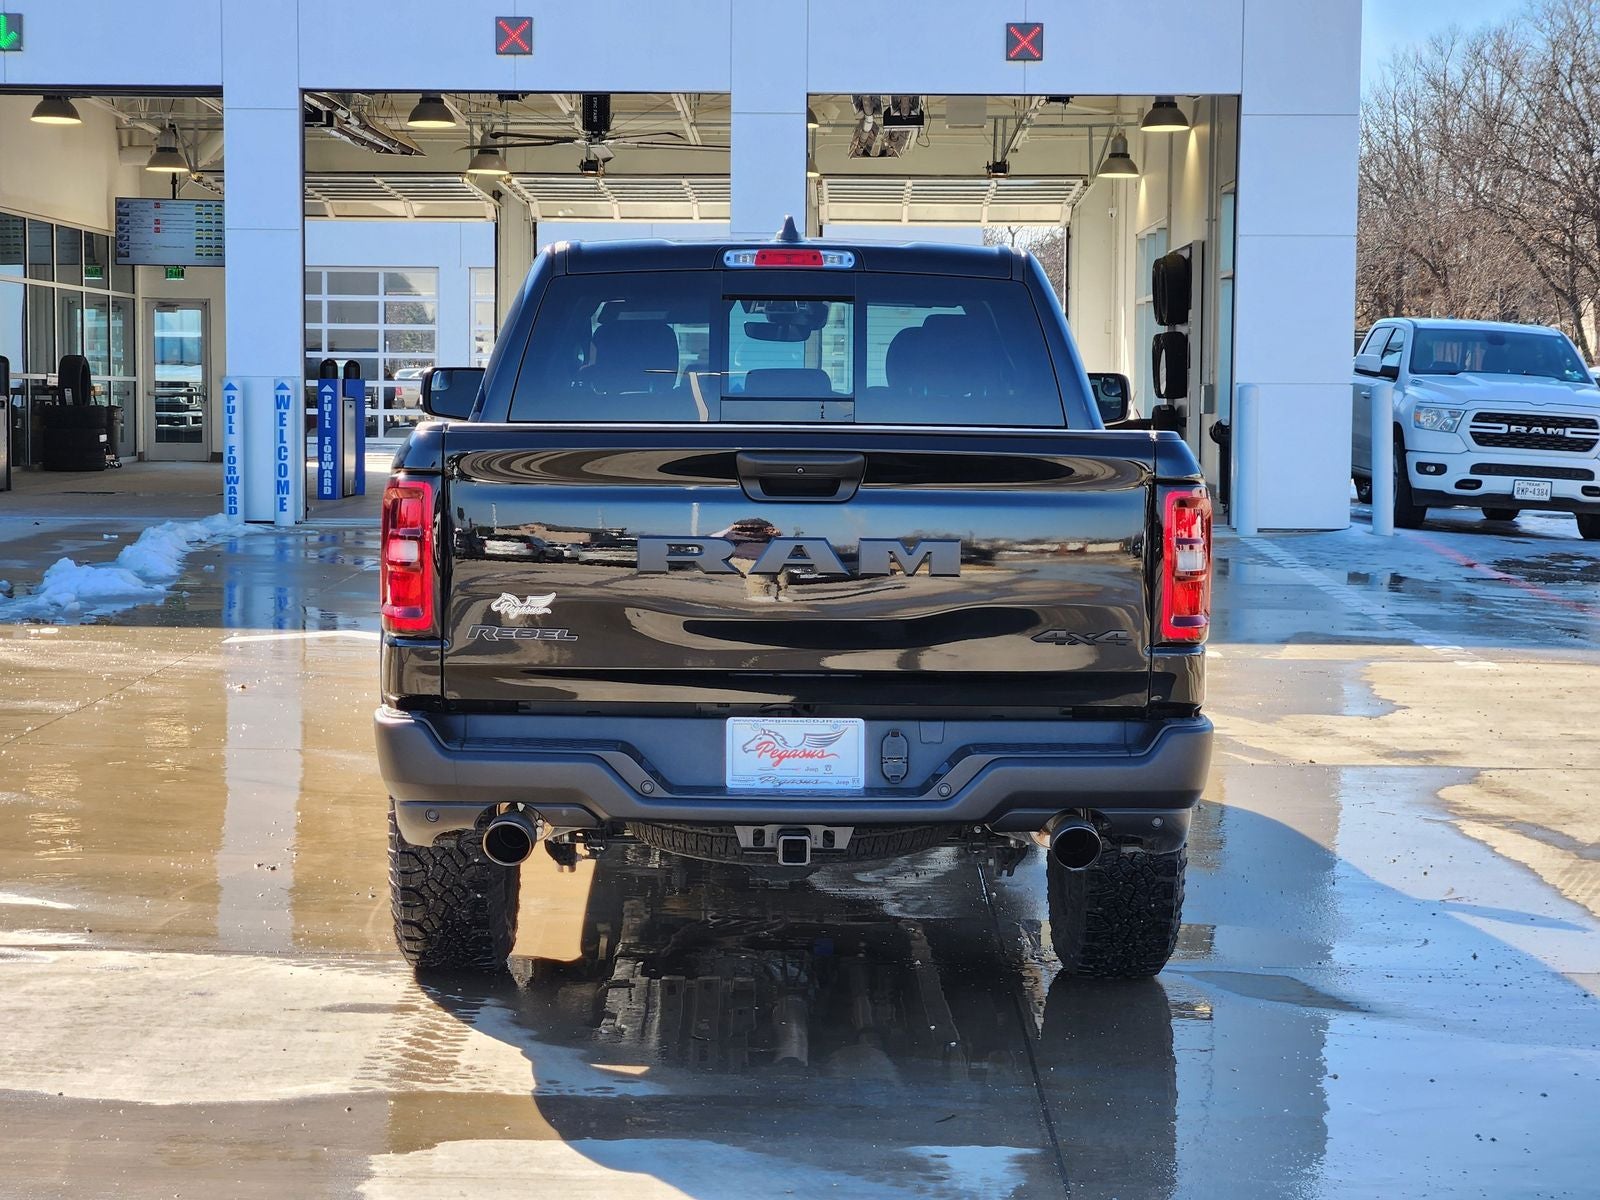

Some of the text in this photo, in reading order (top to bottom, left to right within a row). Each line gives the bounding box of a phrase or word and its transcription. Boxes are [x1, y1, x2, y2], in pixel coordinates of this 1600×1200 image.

[168, 268, 182, 278] EXIT
[1509, 425, 1564, 436] RAM
[225, 395, 240, 515] PULL FORWARD
[275, 395, 291, 512] WELCOME
[321, 395, 334, 495] PULL FORWARD
[637, 535, 961, 577] RAM
[500, 602, 552, 619] Pegasus
[466, 625, 578, 641] REBEL
[756, 741, 840, 767] Pegasus
[759, 775, 833, 787] Pegasus
